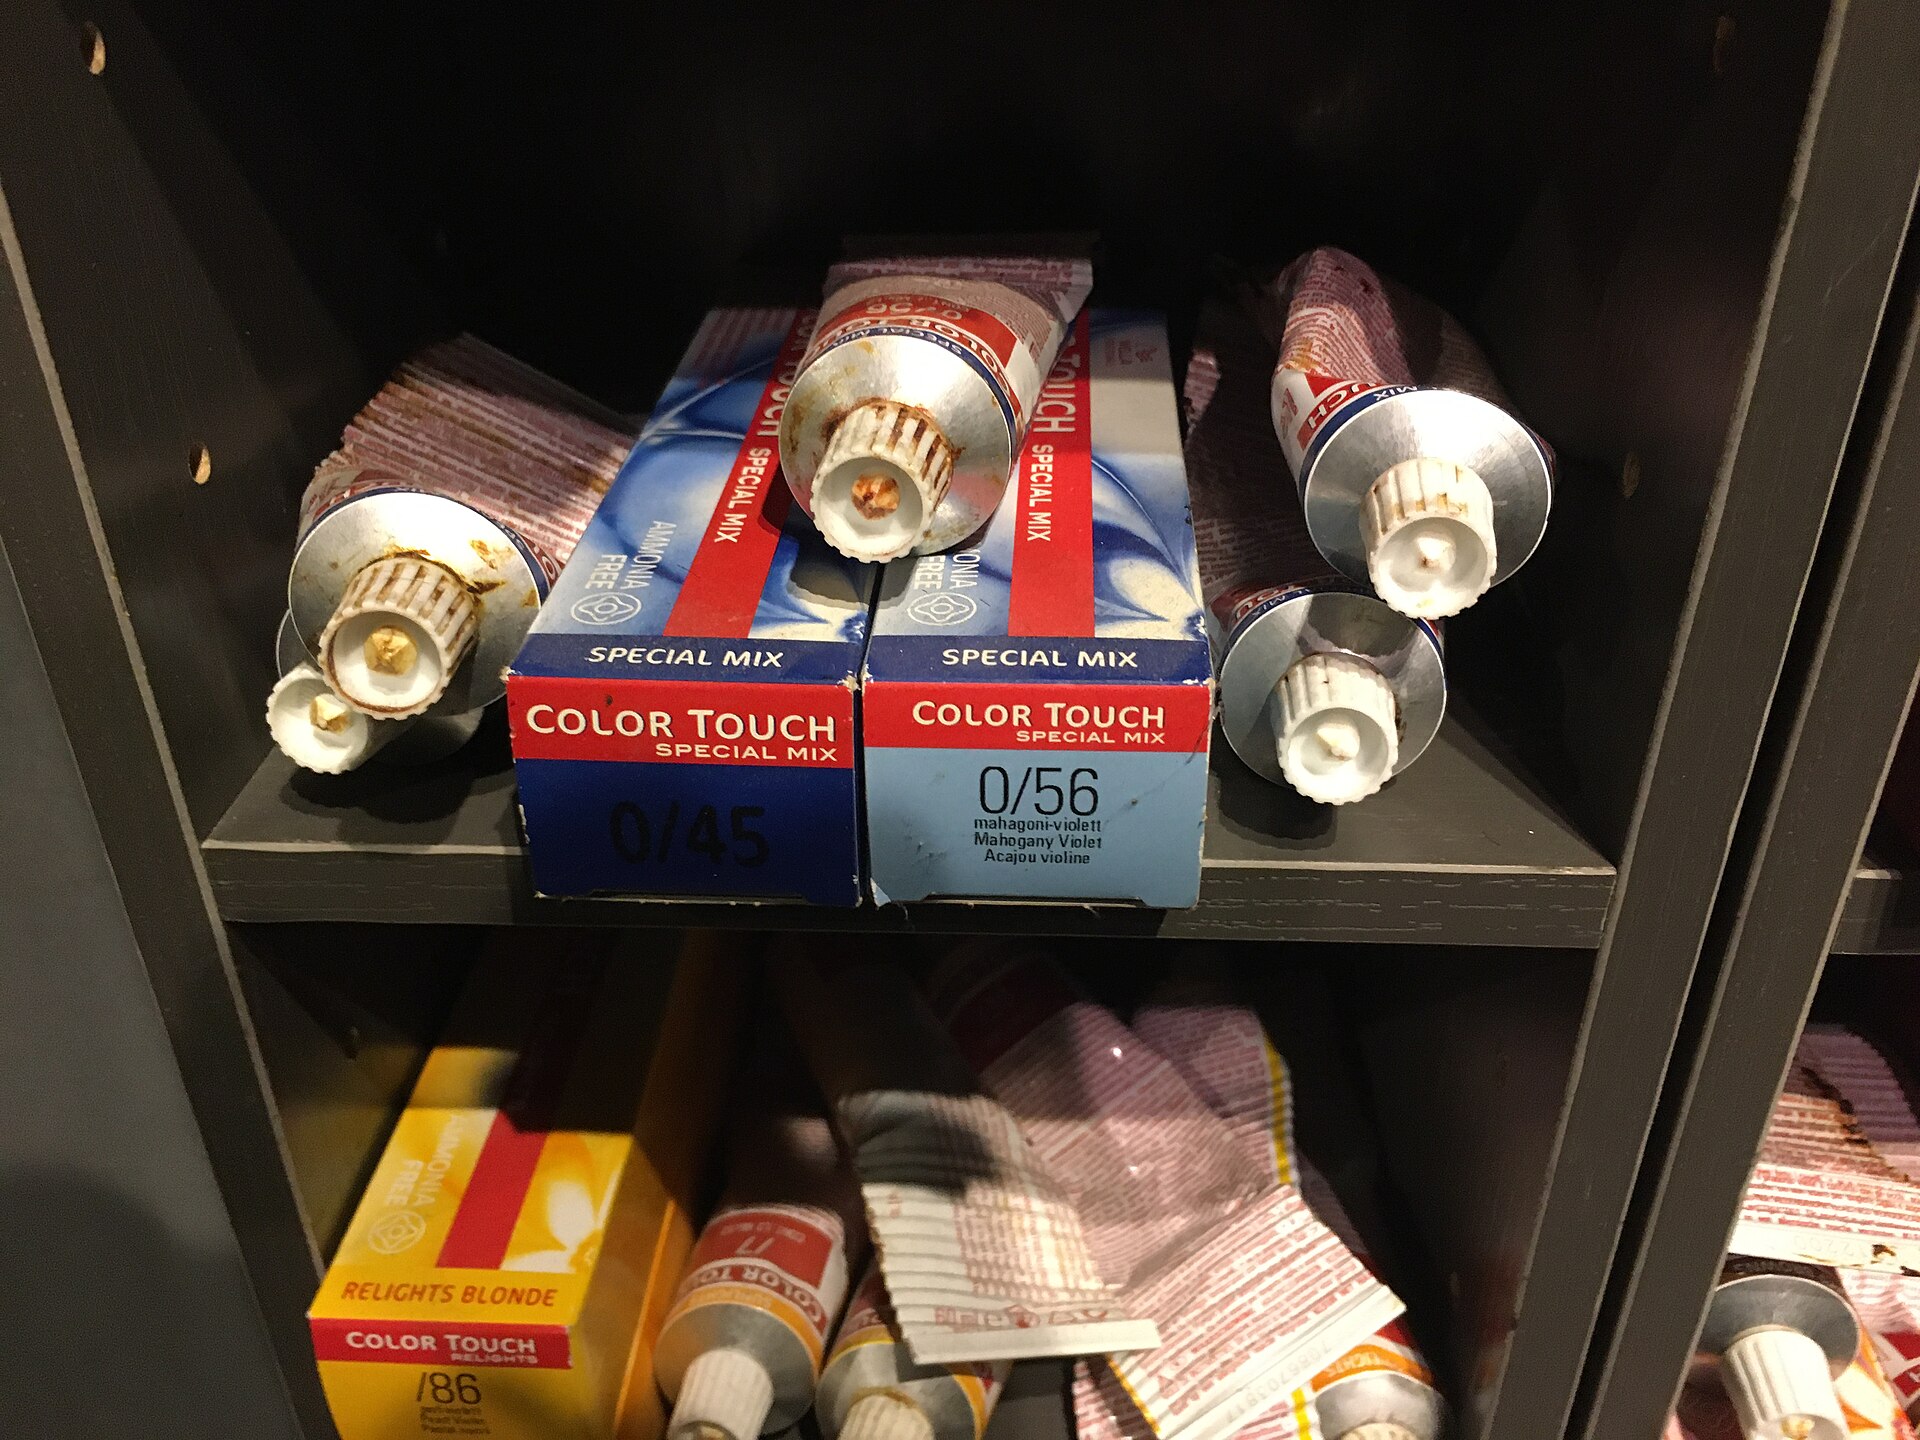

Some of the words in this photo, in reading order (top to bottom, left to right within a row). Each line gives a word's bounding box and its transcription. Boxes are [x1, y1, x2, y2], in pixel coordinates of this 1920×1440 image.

[1307, 382, 1378, 430] UCH
[728, 447, 772, 509] SPECIAL
[1028, 444, 1053, 508] SPECIAL
[714, 513, 747, 544] MIX
[1027, 512, 1052, 542] MIX
[623, 520, 677, 590] AMMONIA
[950, 548, 980, 590] ONIA
[585, 554, 628, 590] FREE
[914, 555, 946, 590] FREE
[587, 647, 712, 667] SPECIAL
[722, 649, 784, 668] MIX
[942, 649, 1067, 667] SPECIAL
[1077, 651, 1138, 668] MIX
[526, 704, 674, 738] COLOR
[688, 709, 837, 742] TOUCH
[912, 700, 1032, 727] COLOR
[1044, 702, 1166, 729] TOUCH
[655, 743, 777, 760] SPECIAL
[787, 746, 838, 762] MIX
[1016, 730, 1115, 744] SPECIAL
[1123, 732, 1166, 745] MIX
[979, 766, 1099, 816] 0/56
[608, 801, 771, 868] 0/45
[974, 816, 1102, 833] mahagoni-violett
[974, 832, 1054, 850] Mahogany
[1058, 833, 1102, 849] Violet
[984, 849, 1037, 865] Acajou
[1040, 850, 1091, 864] violine
[341, 1281, 455, 1304] RELIGHTS
[460, 1285, 558, 1307] BLONDE
[741, 1263, 822, 1323] COLOR
[345, 1331, 438, 1351] COLOR
[443, 1333, 537, 1354] TOUCH
[450, 1353, 538, 1364] RELIGHTS
[416, 1371, 482, 1405] /86
